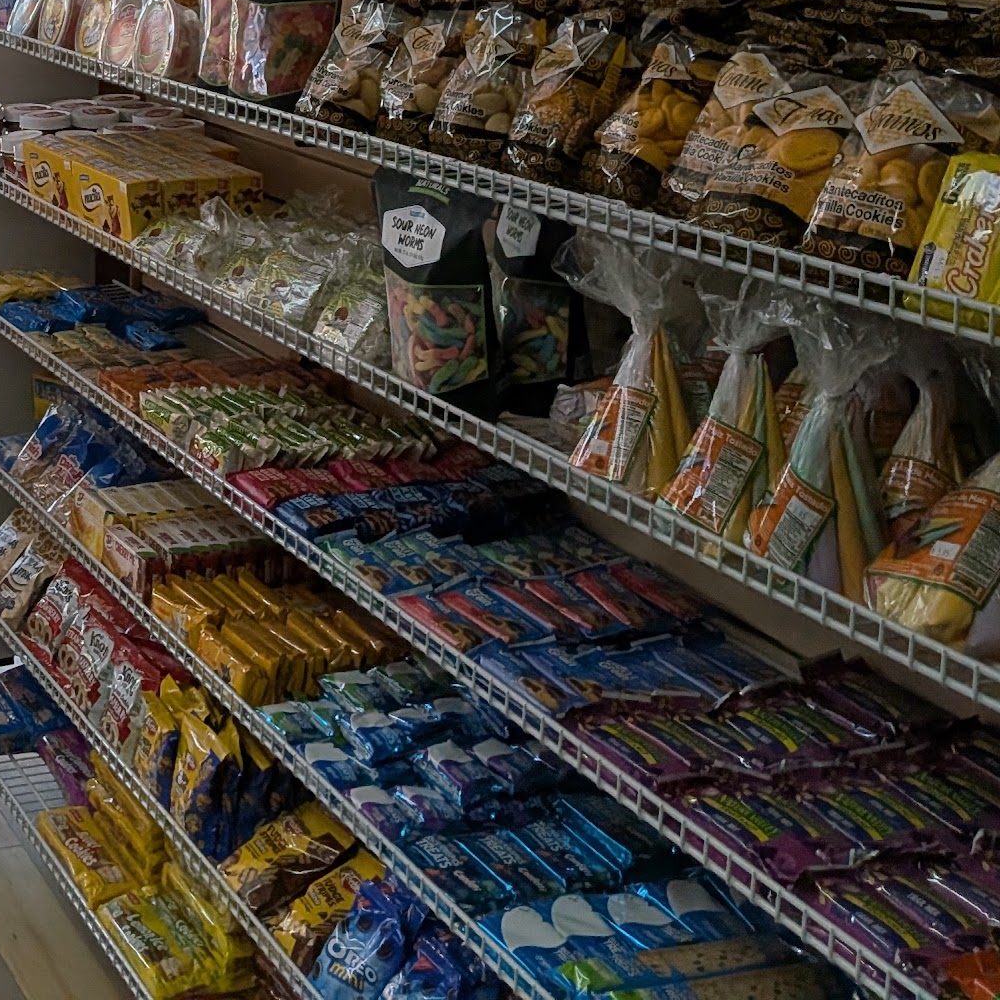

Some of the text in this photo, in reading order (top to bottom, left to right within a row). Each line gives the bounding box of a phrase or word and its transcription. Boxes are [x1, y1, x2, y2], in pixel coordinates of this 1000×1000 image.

[713, 169, 791, 194] Vanilla Cookies
[727, 158, 794, 181] Mantecaditos
[415, 178, 450, 196] NATURALS
[845, 201, 905, 229] Cookies
[391, 216, 437, 240] SOUR NEON
[398, 234, 425, 251] WORMS
[415, 837, 453, 869] TREATS
[322, 876, 344, 902] FUDGE
[327, 938, 377, 983] OREO
[329, 960, 364, 990] mini
